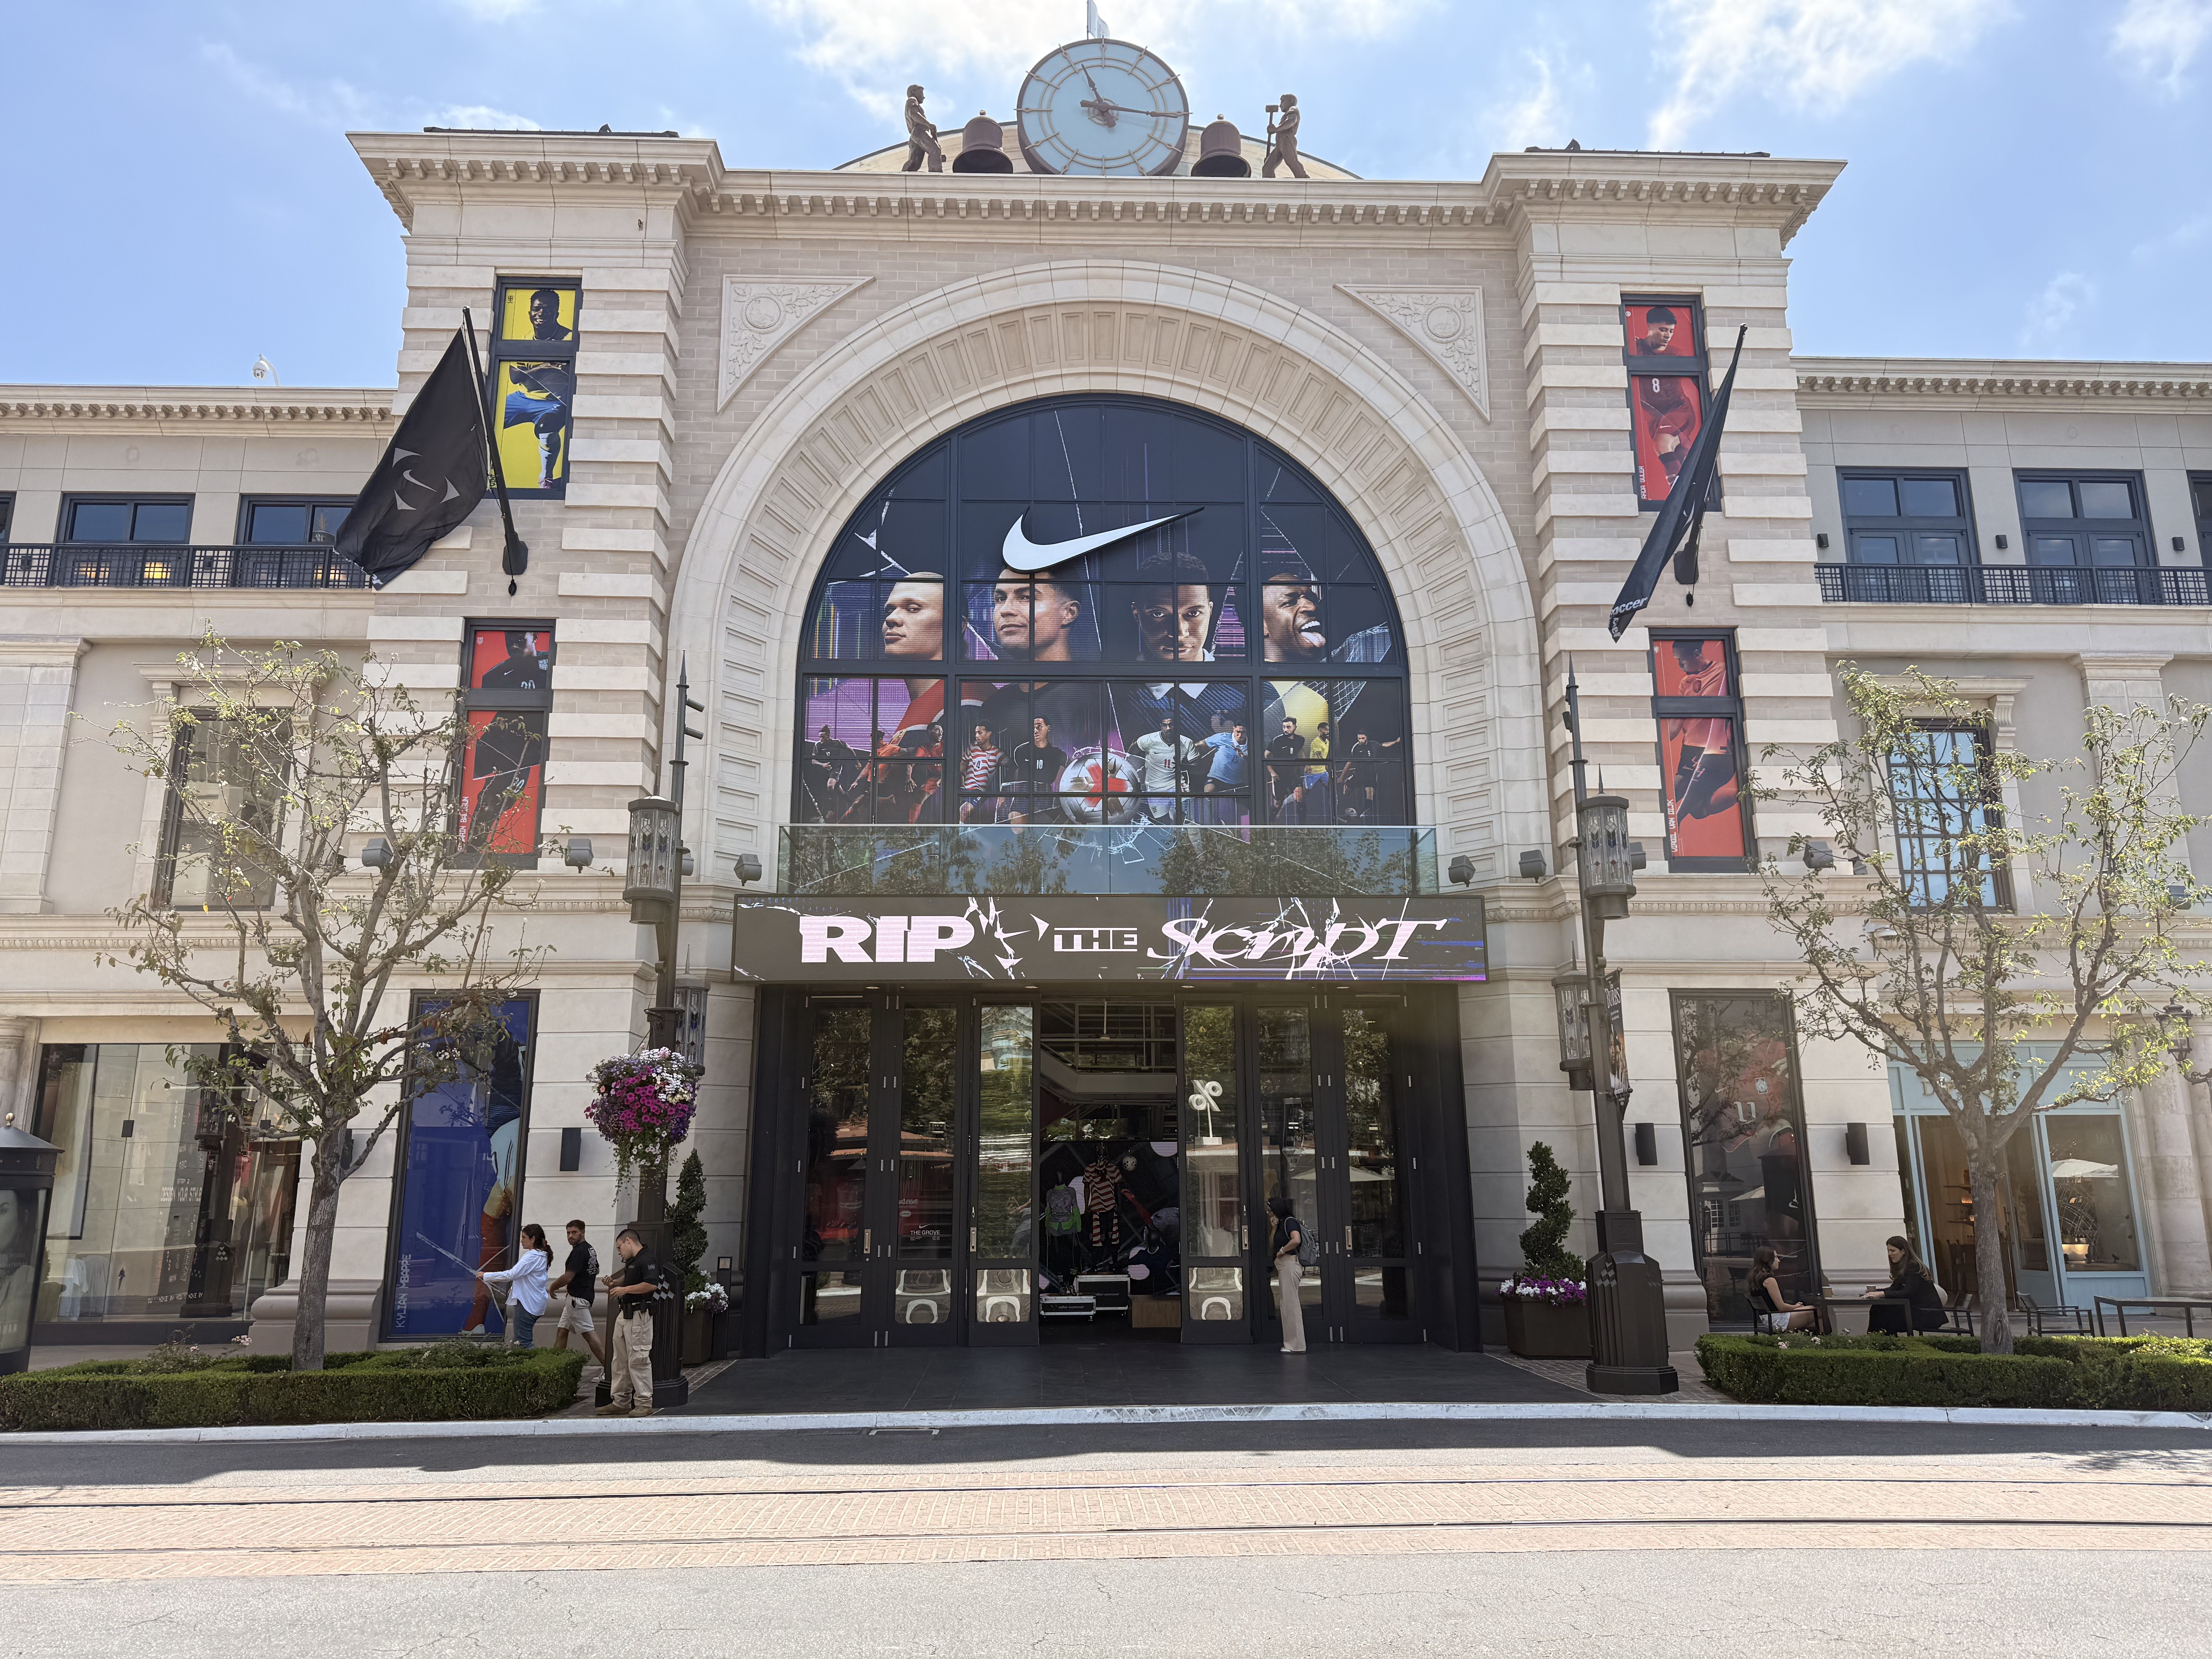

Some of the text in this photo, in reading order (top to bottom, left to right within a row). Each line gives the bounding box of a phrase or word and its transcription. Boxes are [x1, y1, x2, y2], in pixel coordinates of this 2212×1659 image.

[1652, 378, 1660, 393] 8
[976, 761, 981, 769] 4
[1036, 759, 1043, 769] 10
[1164, 758, 1171, 769] 11
[1667, 799, 1675, 815] DIJK
[1670, 832, 1678, 852] VIRGIL
[800, 915, 975, 963] RIP
[1054, 927, 1138, 952] THE
[1733, 1101, 1756, 1122] 11
[178, 1187, 188, 1202] YOUR
[189, 1187, 203, 1202] STYLE
[395, 1254, 411, 1328] KYLIAN MBAPPE
